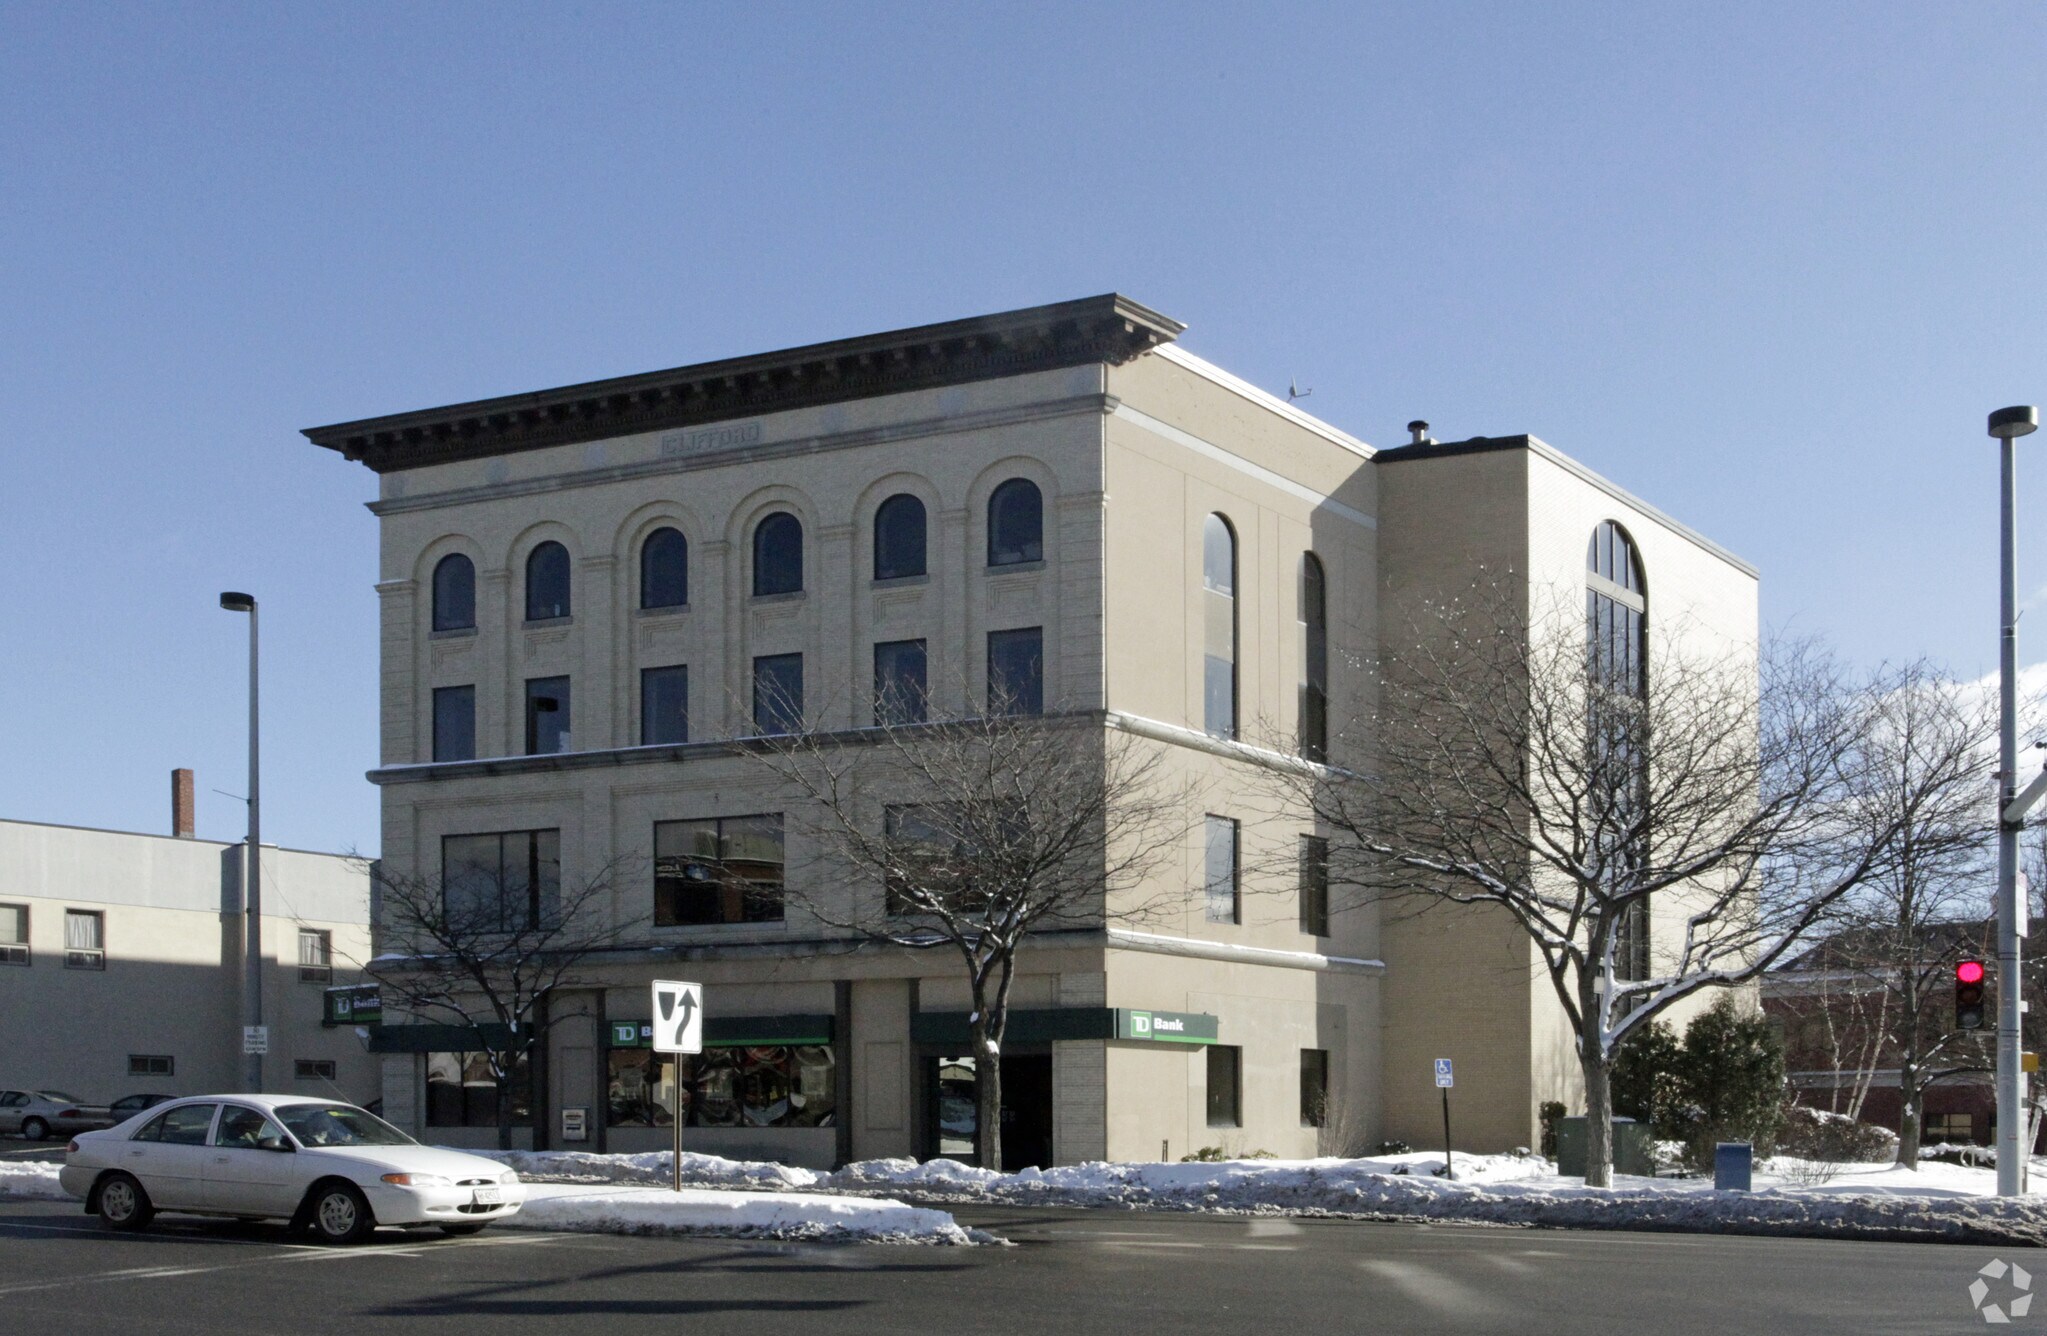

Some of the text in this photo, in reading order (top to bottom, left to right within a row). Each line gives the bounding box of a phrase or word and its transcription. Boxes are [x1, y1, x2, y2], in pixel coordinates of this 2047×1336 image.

[662, 422, 760, 455] CLIFFORD
[1133, 1016, 1184, 1032] TD Bank
[615, 1026, 635, 1041] TD
